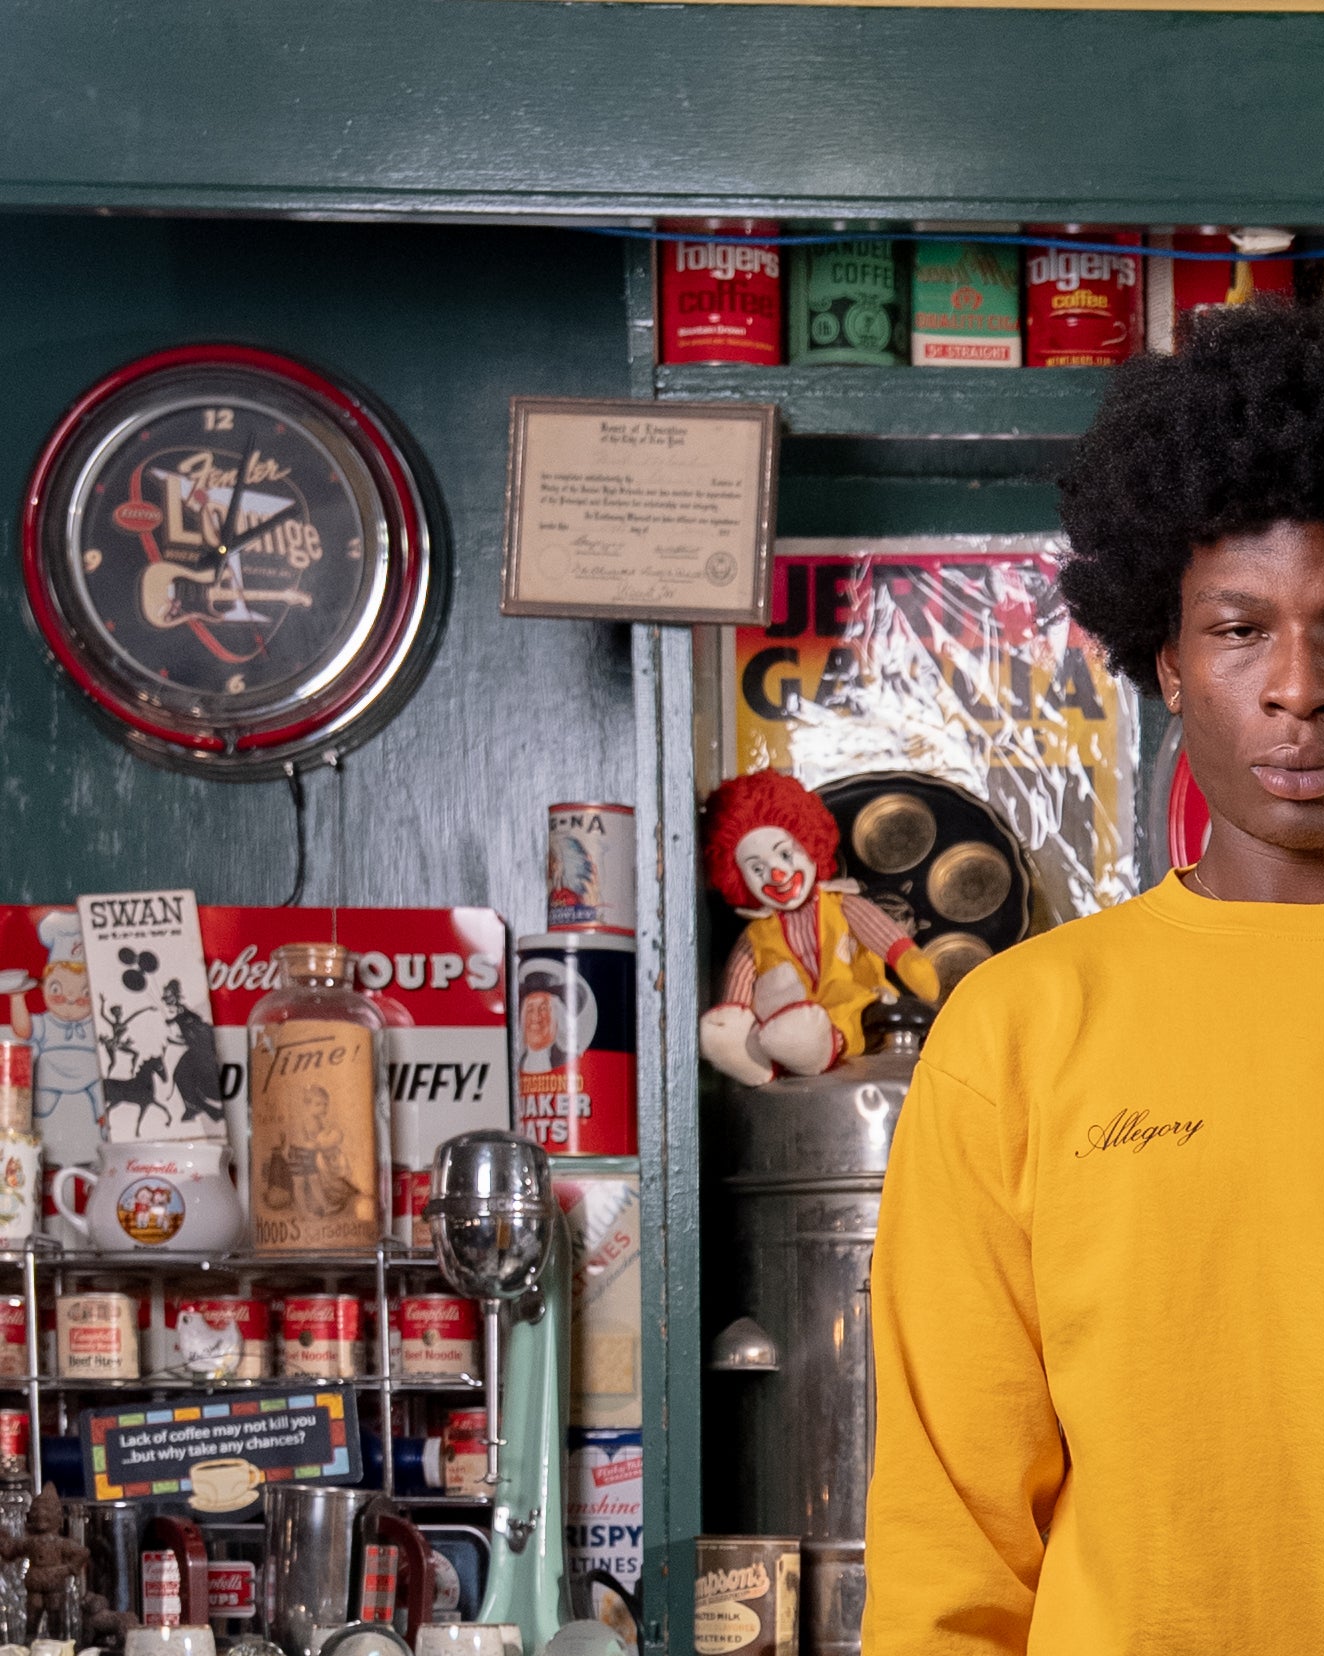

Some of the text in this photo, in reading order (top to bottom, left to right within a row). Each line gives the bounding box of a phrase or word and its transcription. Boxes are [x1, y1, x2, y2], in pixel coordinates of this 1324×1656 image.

[1051, 289, 1109, 309] coffee
[203, 409, 235, 431] 12
[84, 549, 103, 574] 9
[225, 673, 246, 695] 6
[90, 895, 185, 929] SWAN
[357, 950, 500, 991] OUPS
[1075, 1108, 1204, 1158] Allegory
[119, 1415, 317, 1448] Lack of coffee may not kill you
[121, 1430, 306, 1465] ...but why take any chances?
